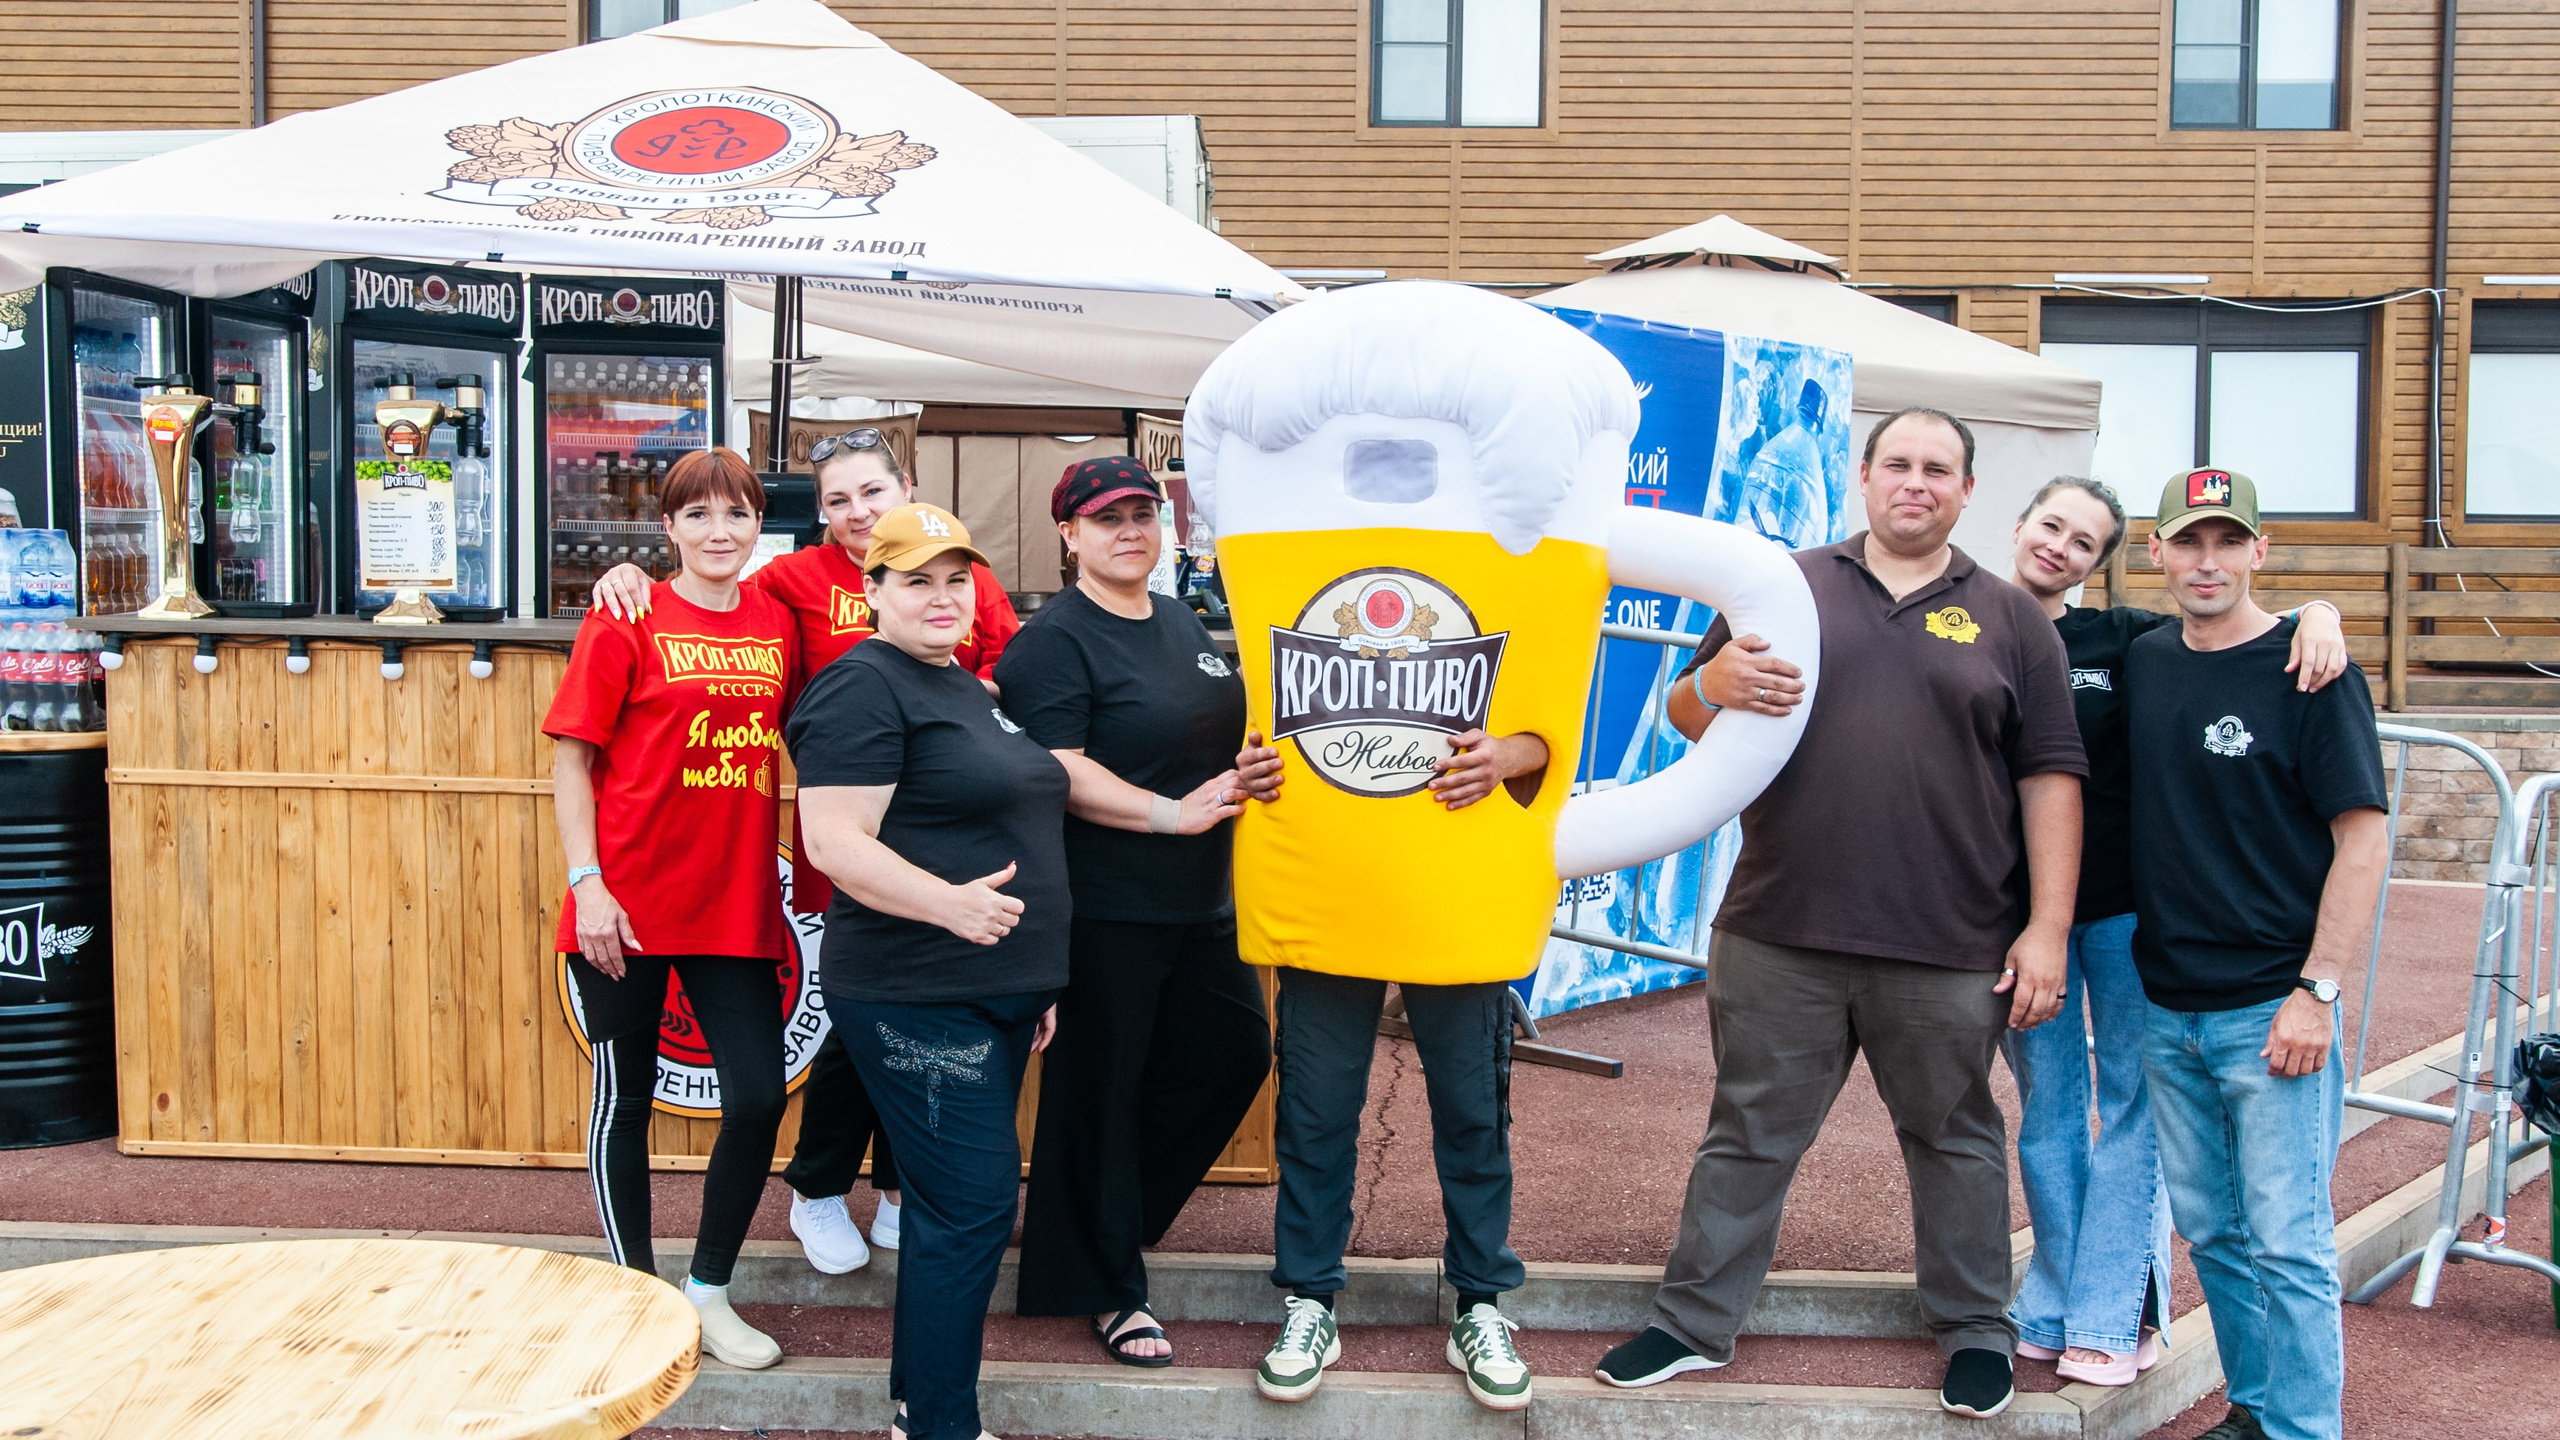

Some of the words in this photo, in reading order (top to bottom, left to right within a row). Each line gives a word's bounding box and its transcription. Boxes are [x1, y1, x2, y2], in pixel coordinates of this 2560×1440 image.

[607, 92, 822, 133] КРОПОТКИНСКИЙ
[581, 132, 744, 187] ПИВОВАРЕННЫЙ
[747, 140, 820, 178] ЗАВОД
[530, 181, 660, 204] Основан
[705, 191, 808, 203] 1908г.
[832, 238, 928, 259] ЗАВОД
[354, 266, 414, 310] КРОП
[457, 281, 516, 324] ПИВО
[541, 285, 603, 326] КРОП
[651, 289, 715, 330] ПИВО
[916, 510, 951, 538] LA
[720, 683, 763, 697] СССР
[686, 710, 711, 749] Я
[682, 751, 748, 788] тебя
[1322, 730, 1437, 774] Живое
